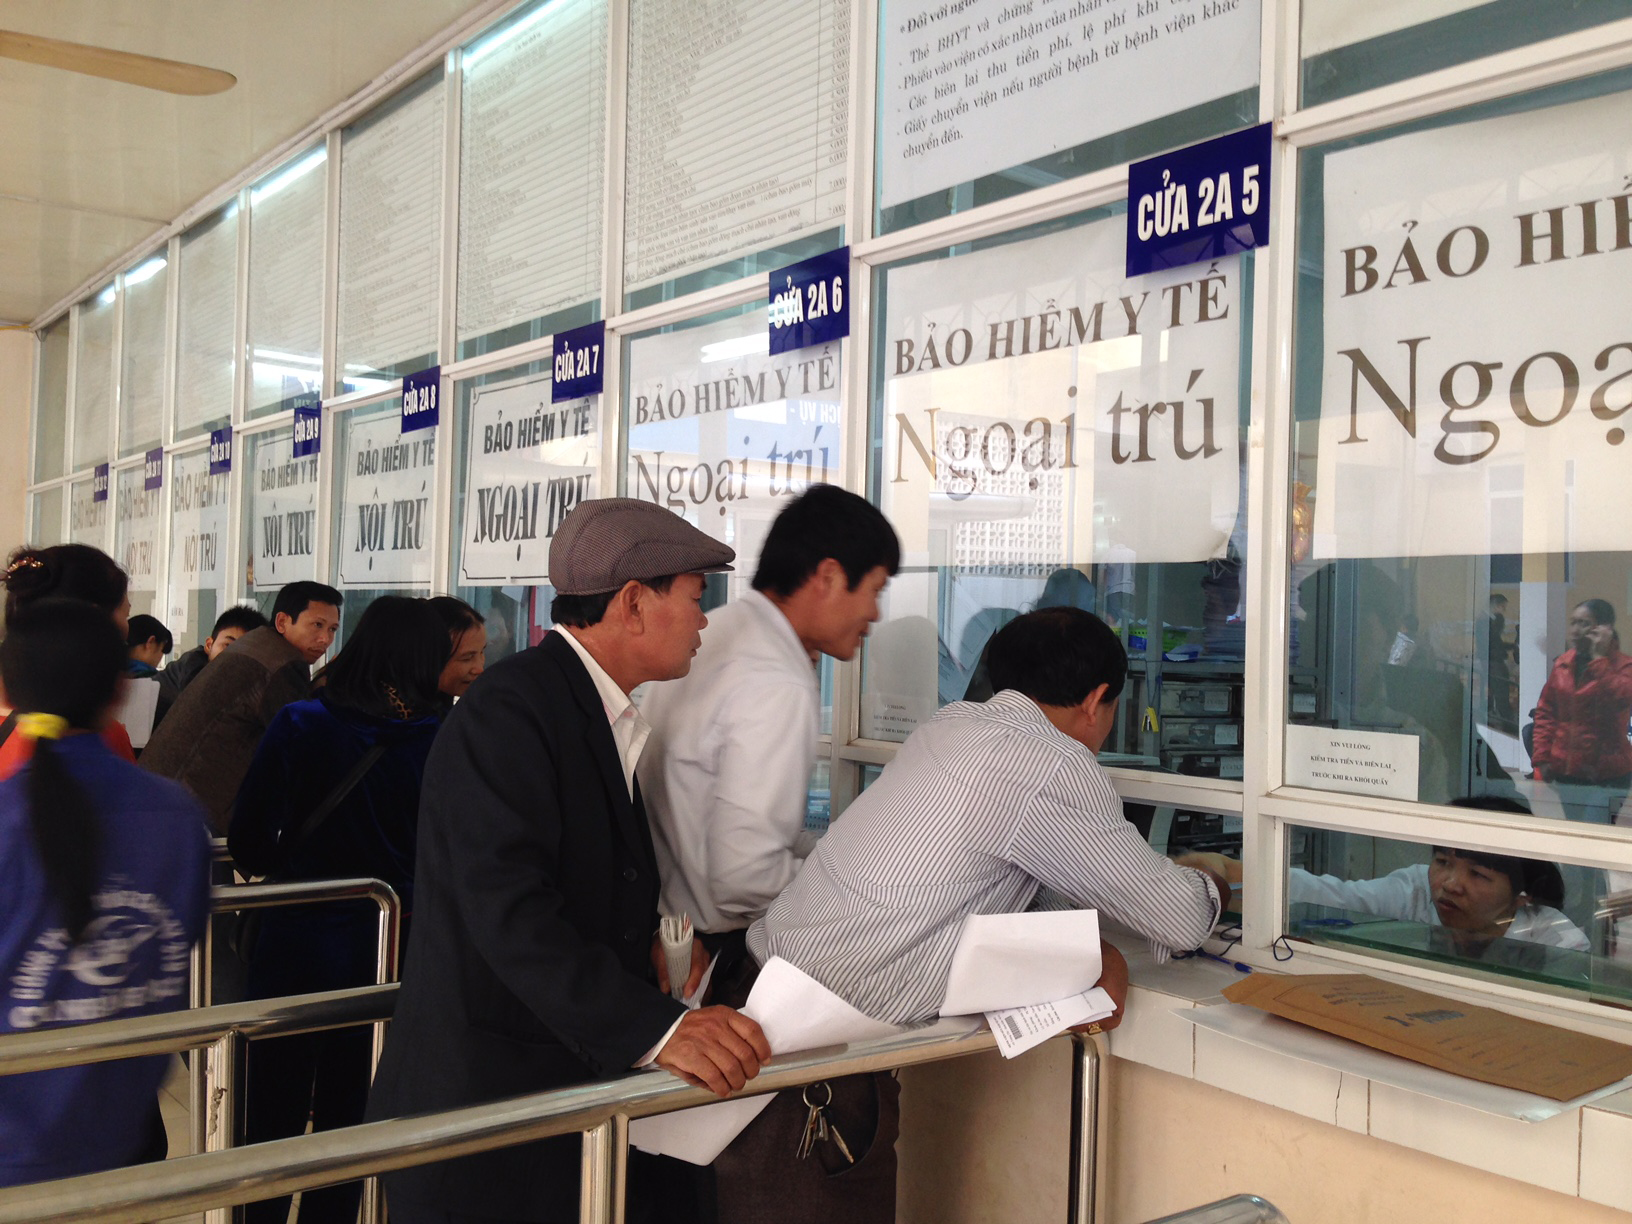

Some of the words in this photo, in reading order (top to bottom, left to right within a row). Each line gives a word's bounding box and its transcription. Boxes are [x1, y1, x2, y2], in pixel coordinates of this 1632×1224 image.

[908, 93, 927, 111] Các
[934, 81, 956, 100] biên
[965, 69, 979, 88] lai
[987, 62, 1007, 79] thu
[1016, 46, 1039, 67] tiền
[1082, 25, 1094, 41] lệ
[1104, 9, 1126, 35] phí
[931, 97, 969, 125] chuyển
[973, 91, 998, 109] viện
[1002, 76, 1024, 98] nếu
[1029, 60, 1063, 89] người
[1067, 49, 1099, 73] bệnh
[1105, 40, 1119, 58] từ
[1125, 25, 1159, 50] bệnh
[1165, 13, 1196, 34] viện
[935, 61, 952, 76] vào
[954, 49, 976, 68] viện
[991, 34, 1010, 51] xác
[1012, 21, 1043, 43] nhận
[1045, 10, 1066, 29] của
[937, 24, 971, 52] BHYT
[977, 17, 989, 33] và
[903, 132, 939, 160] chuyển
[1137, 169, 1190, 242] CỬA
[1197, 172, 1233, 227] 2A
[1241, 164, 1261, 217] 5
[1340, 219, 1490, 298] BẢO
[773, 275, 804, 330] CỬA
[808, 280, 828, 321] 2A
[832, 275, 843, 314] 6
[893, 322, 974, 377] BẢO
[987, 298, 1105, 361] HIỂM
[1118, 291, 1152, 337] Y
[1161, 262, 1230, 329] TẾ
[403, 380, 418, 417] CỬA
[419, 386, 430, 412] 2A
[430, 383, 437, 409] 8
[555, 341, 575, 384] CỬA
[577, 348, 590, 378] 2A
[592, 344, 600, 374] 7
[635, 383, 686, 425] BẢO
[693, 368, 767, 415] HIỂM
[774, 366, 793, 399] Y
[798, 345, 835, 395] TẾ
[357, 439, 379, 476] BẢO
[381, 434, 409, 473] HIỂM
[413, 441, 420, 468] Y
[484, 410, 513, 455] BẢO
[517, 402, 555, 449] HIỂM
[560, 409, 569, 441] Y
[890, 385, 1080, 501] Ngoại
[1106, 368, 1223, 465] trú
[261, 459, 276, 492] BẢO
[277, 454, 299, 489] HIỂM
[301, 460, 307, 484] Y
[632, 435, 750, 520] Ngoại
[767, 426, 829, 498] trú
[200, 521, 217, 571] TRÚ
[262, 501, 283, 574] NỘI
[286, 493, 316, 556] TRÚ
[355, 486, 388, 571] NỘI
[391, 480, 429, 550] TRÚ
[473, 481, 541, 561] NGOẠI
[1332, 773, 1344, 781] KHI
